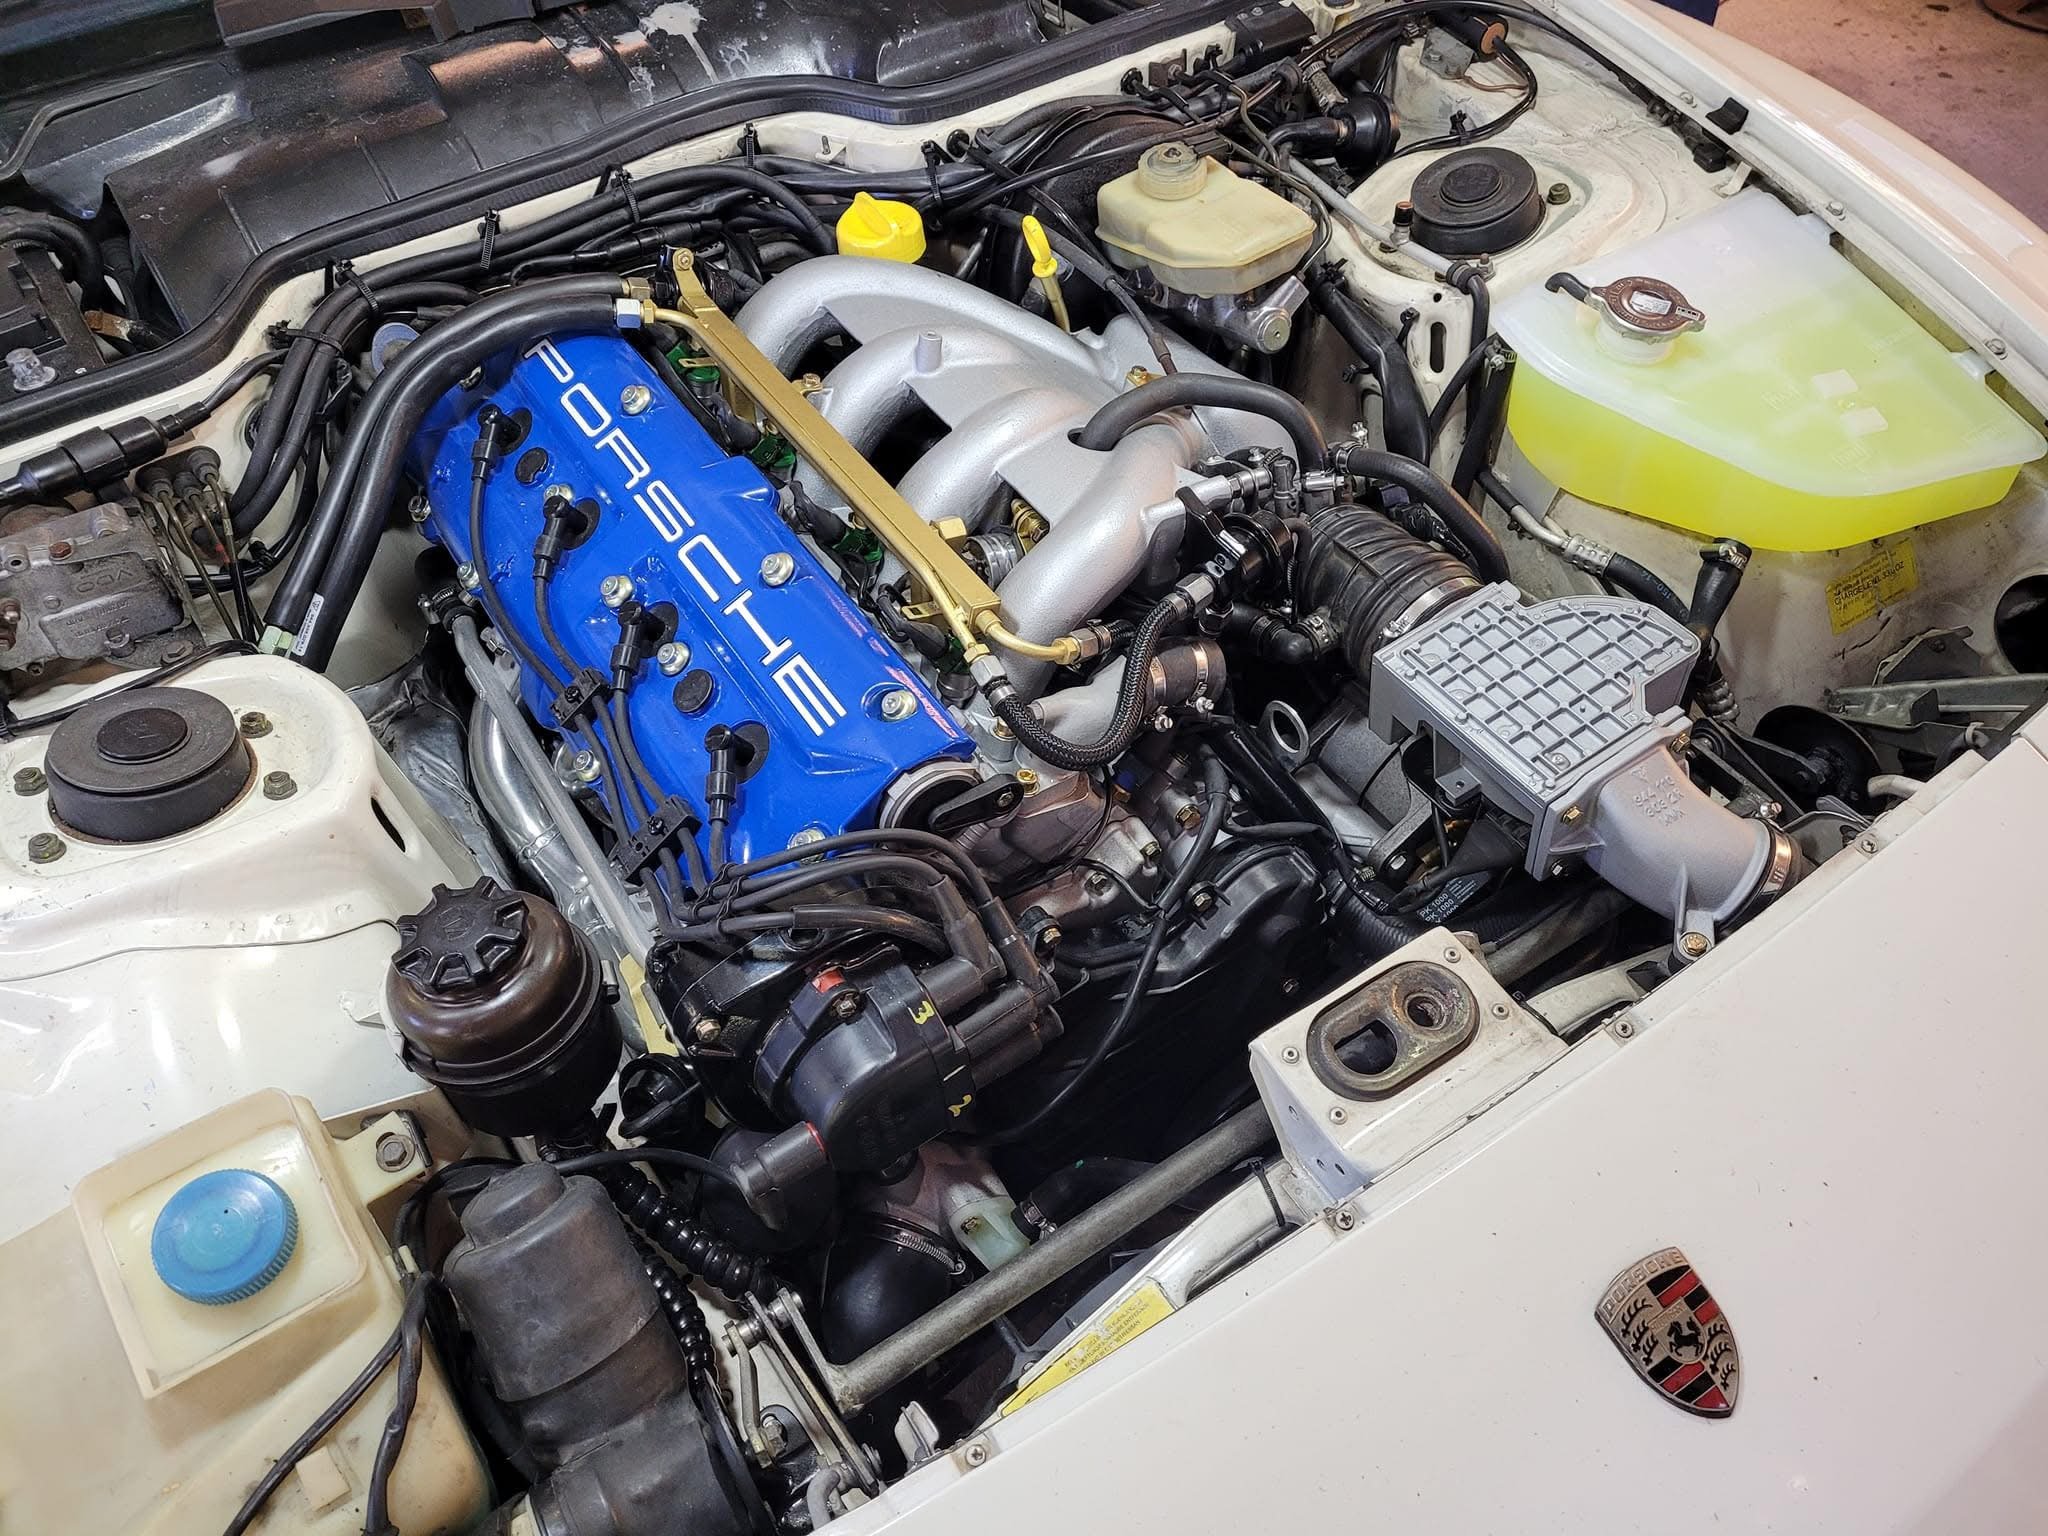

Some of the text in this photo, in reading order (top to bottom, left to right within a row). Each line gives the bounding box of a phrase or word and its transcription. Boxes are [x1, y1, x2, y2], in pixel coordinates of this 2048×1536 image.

[524, 338, 848, 737] PORSCHE
[76, 569, 134, 593] VDO
[1419, 893, 1449, 918] PK 1000
[1437, 899, 1455, 913] 1000
[907, 1000, 935, 1025] 3
[1601, 1250, 1682, 1318] PORSCHE
